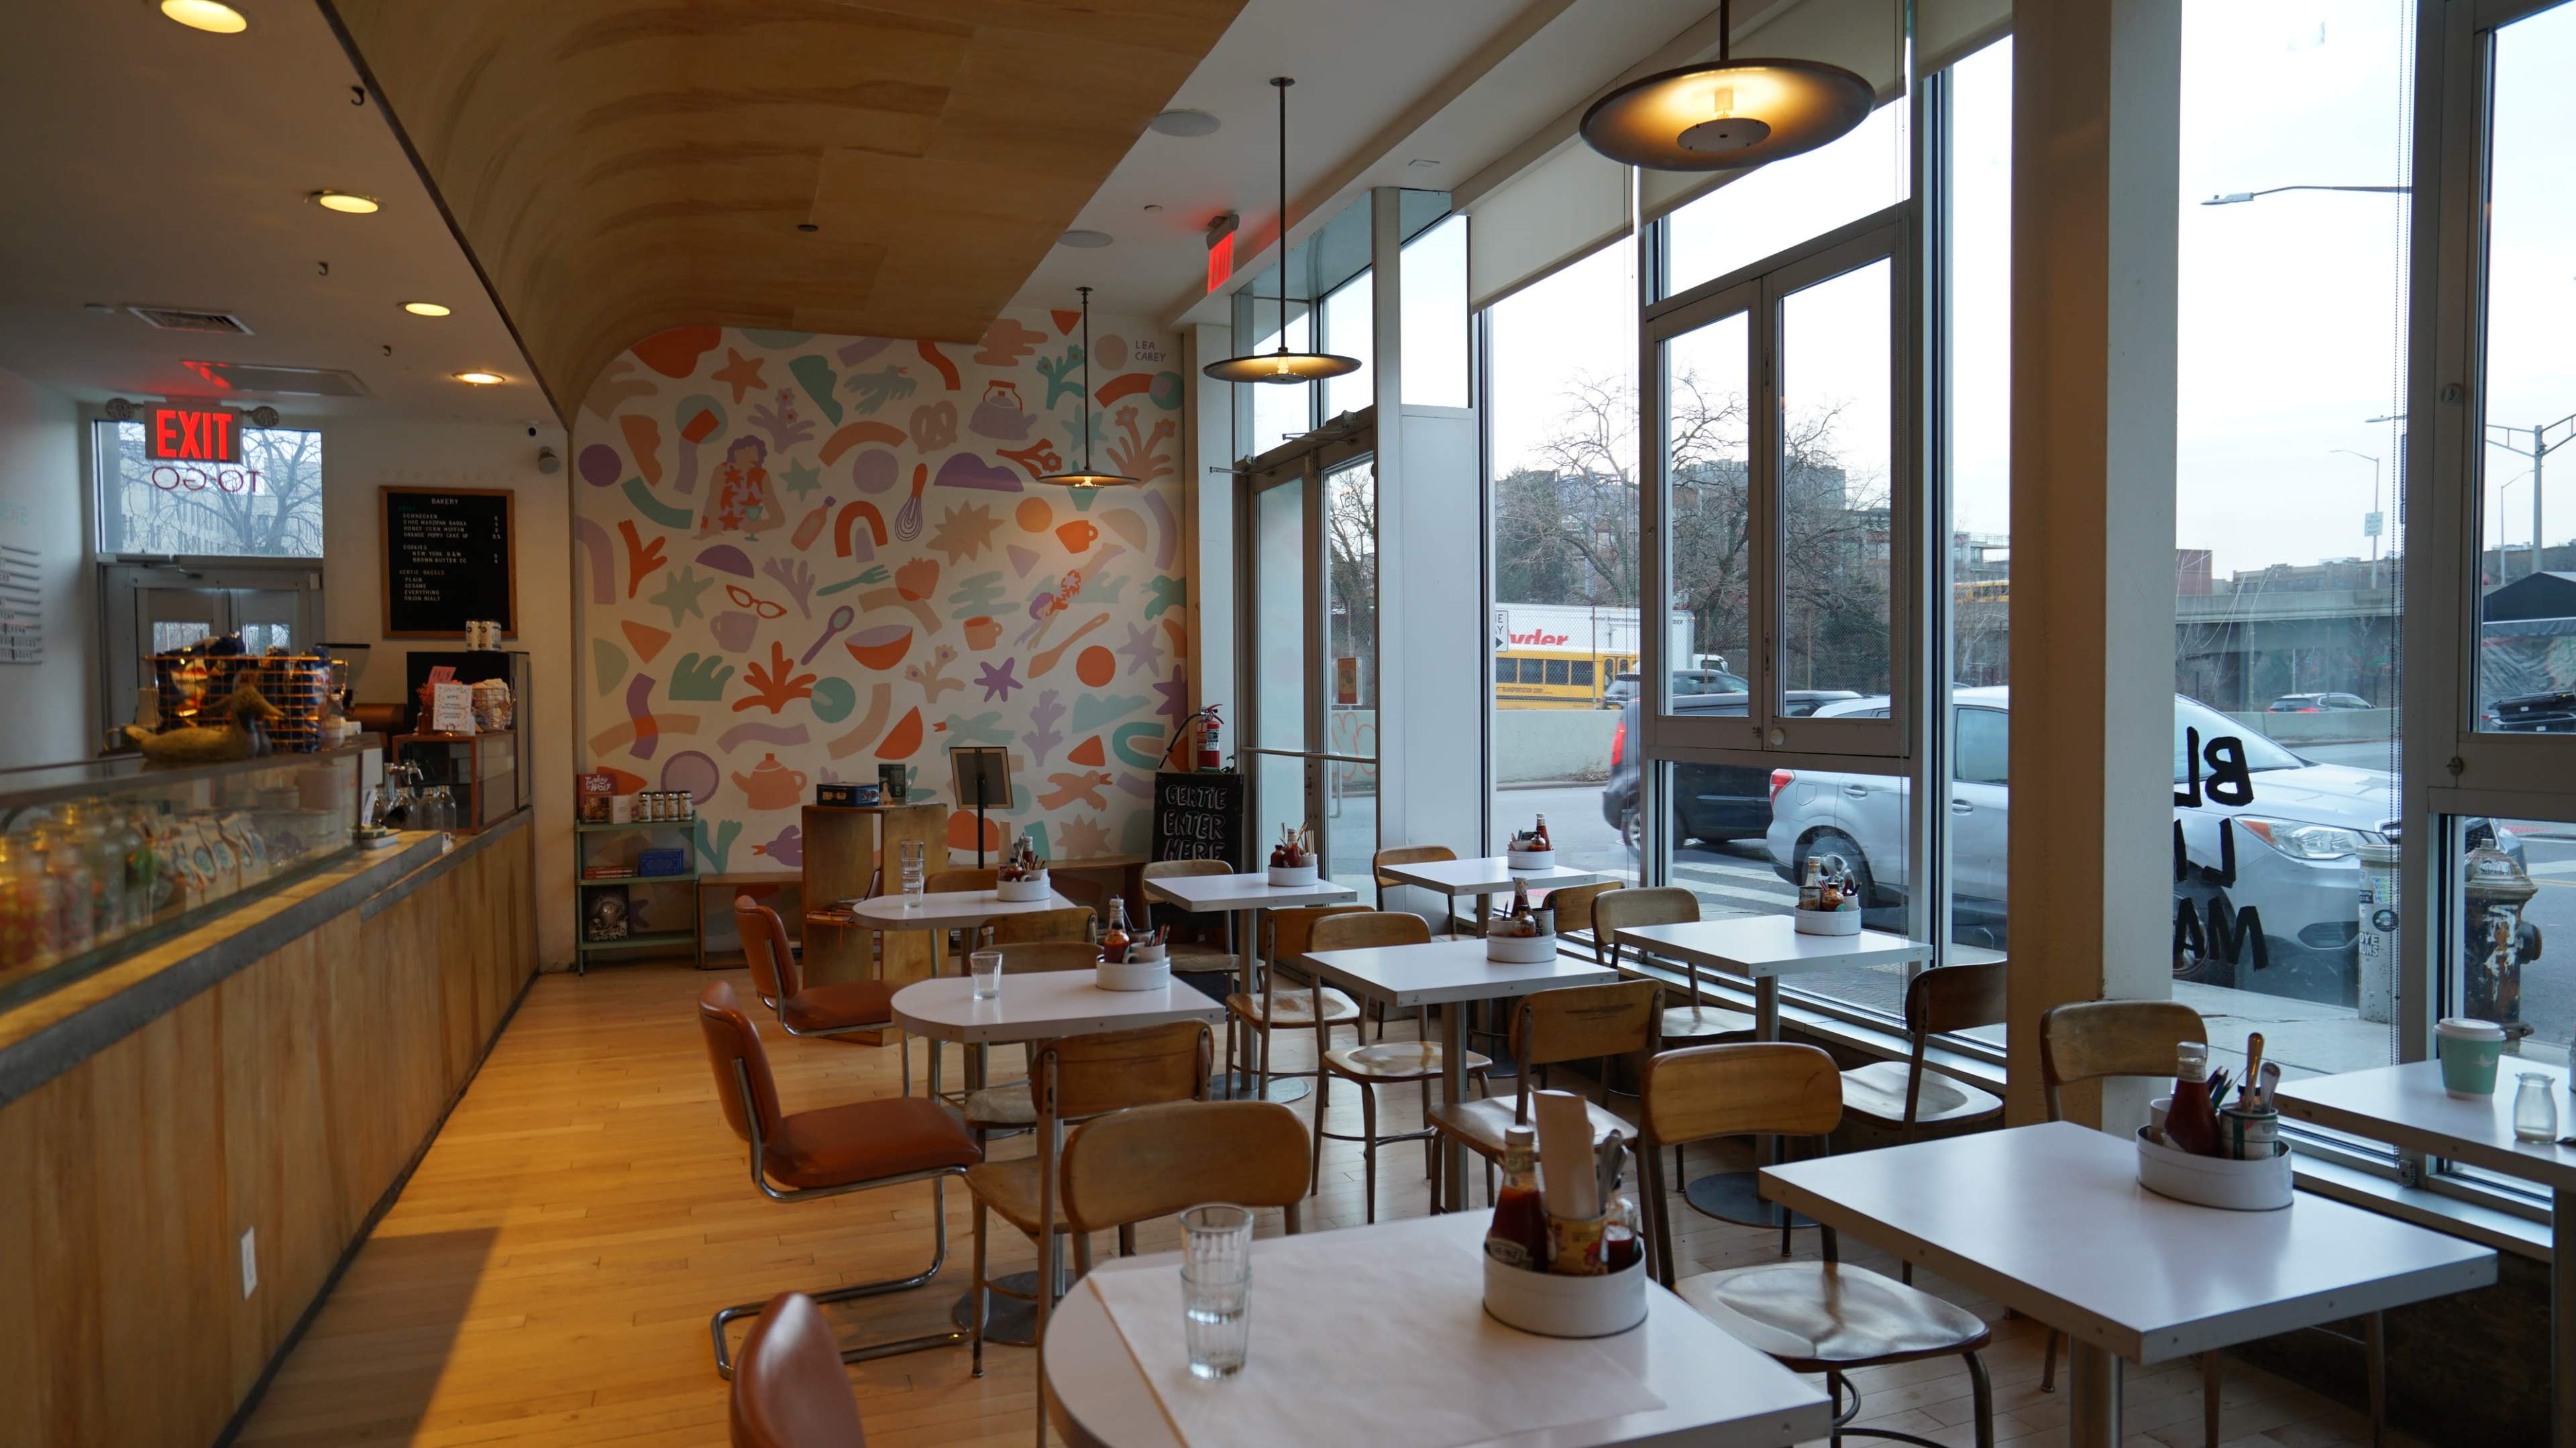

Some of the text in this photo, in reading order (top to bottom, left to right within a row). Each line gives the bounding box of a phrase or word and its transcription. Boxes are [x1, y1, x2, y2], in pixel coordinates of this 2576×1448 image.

[1135, 340, 1155, 350] LEA
[1134, 351, 1167, 363] CAREY
[156, 409, 233, 460] EXIT
[1163, 809, 1226, 840] ENTER
